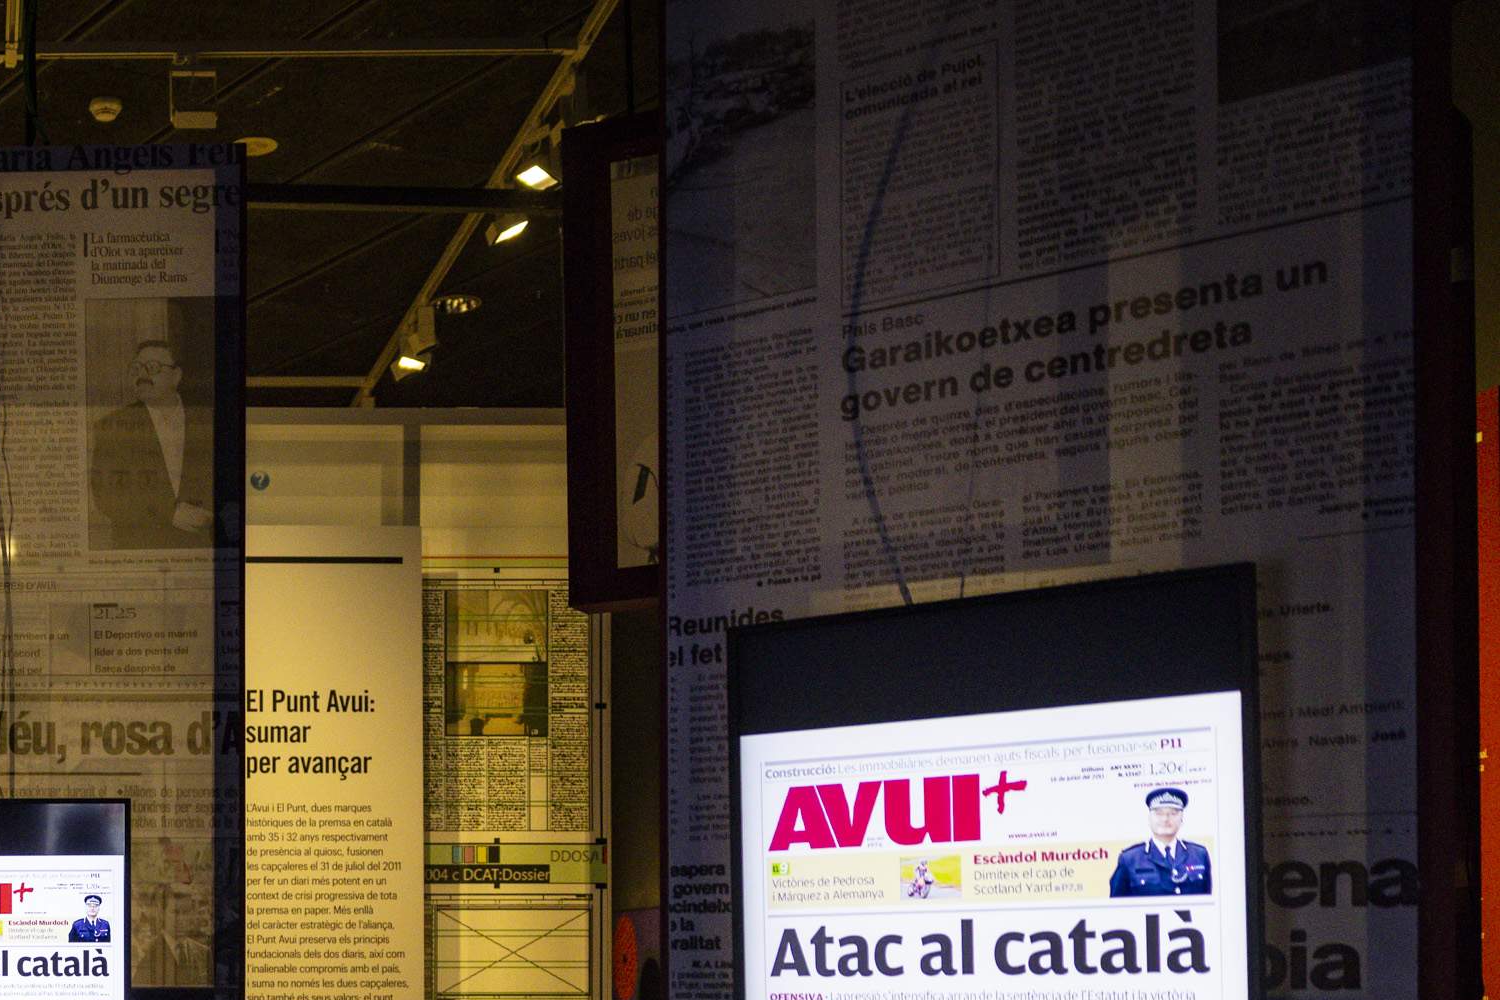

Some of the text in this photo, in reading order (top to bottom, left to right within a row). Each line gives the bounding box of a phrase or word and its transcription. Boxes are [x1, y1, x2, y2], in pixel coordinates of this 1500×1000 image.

[841, 260, 1329, 375] Garaikoetxea presenta un
[839, 320, 1253, 422] govern de centredreta
[247, 689, 376, 713] El Punt Avui:
[80, 720, 174, 756] rosa
[246, 725, 311, 744] sumar
[246, 755, 372, 781] per avançar
[765, 736, 1183, 780] Construcció: P11
[246, 817, 392, 830] històriques premsa català
[268, 832, 388, 844] 35 respectivament
[973, 846, 1109, 866] Escàndol Murdoch
[832, 875, 875, 887] Pedrosa
[973, 867, 1021, 882] Dimiteix
[833, 887, 884, 902] Alemanya
[973, 882, 1022, 896] Scotland
[770, 909, 1212, 978] Atac al català
[17, 948, 109, 977] català
[769, 993, 824, 1000] OFENSIVA
